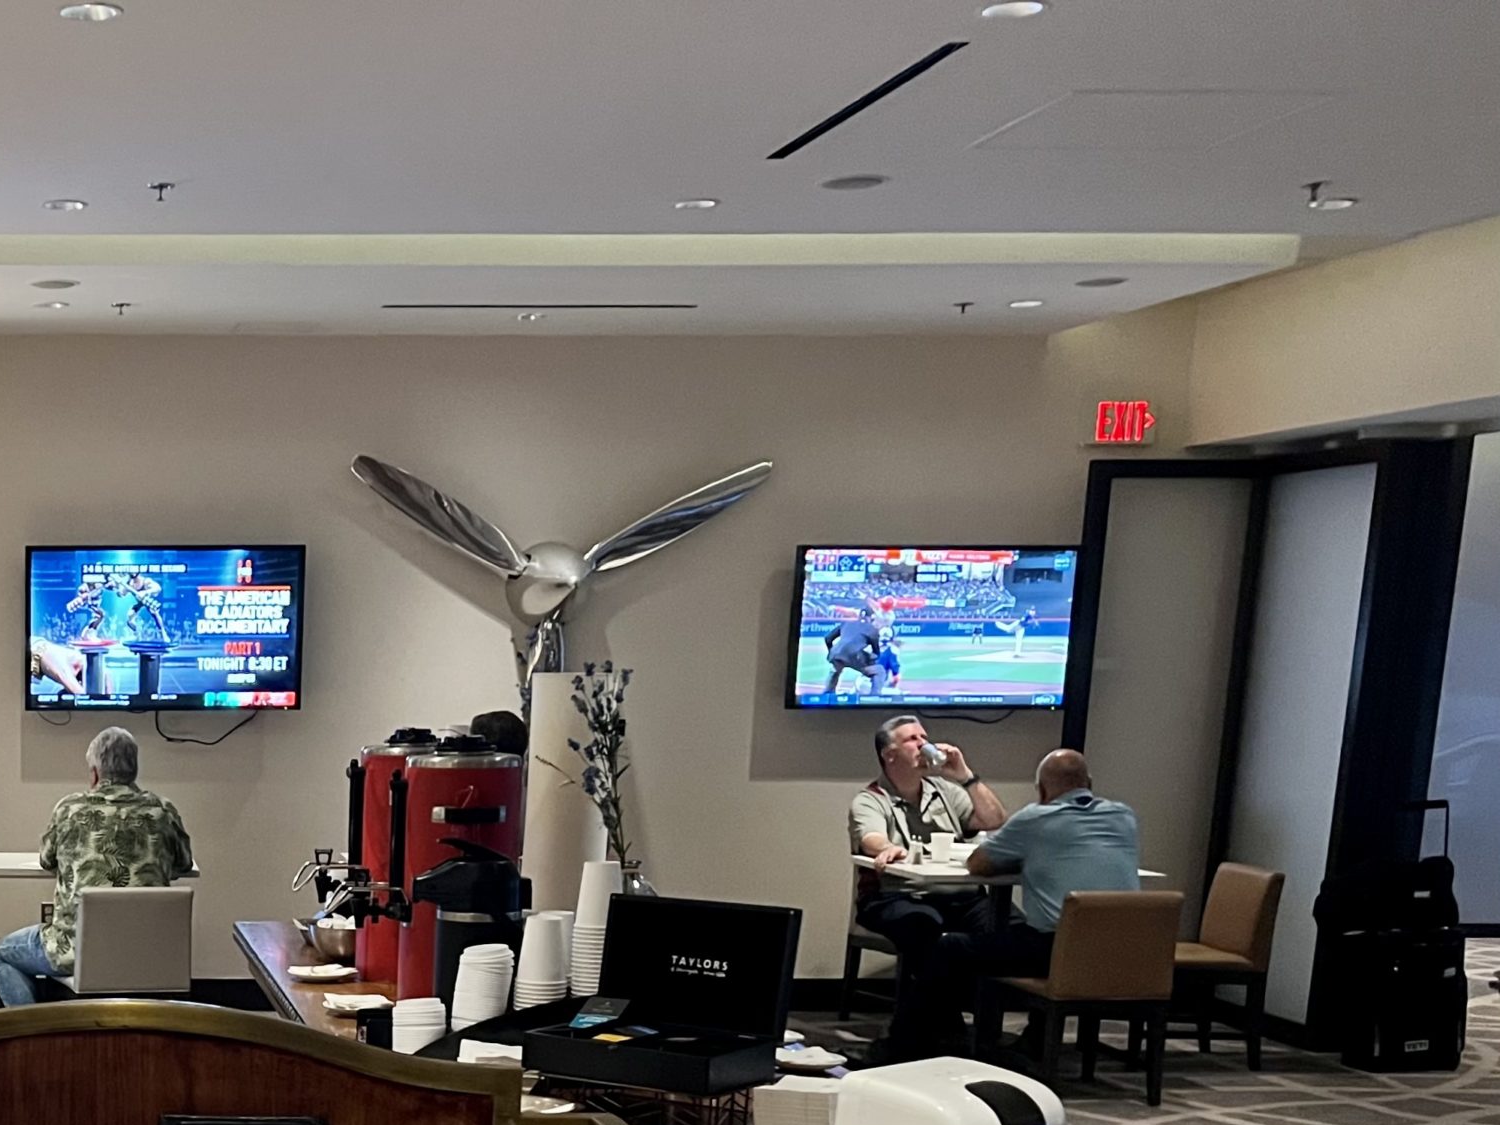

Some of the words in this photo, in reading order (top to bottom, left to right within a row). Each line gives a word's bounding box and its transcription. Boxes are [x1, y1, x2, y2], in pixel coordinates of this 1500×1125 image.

[1095, 401, 1149, 442] EXIT
[198, 591, 225, 605] THE
[225, 590, 291, 605] AMERICAN
[204, 605, 283, 619] GLADIATORS
[197, 619, 290, 634] DOCUMENTARY
[224, 642, 254, 655] PART
[254, 642, 261, 655] 1
[197, 657, 246, 671] TONIGHT
[273, 656, 288, 671] ET
[671, 954, 729, 972] TAYLORS
[1406, 1041, 1428, 1051] YETI
